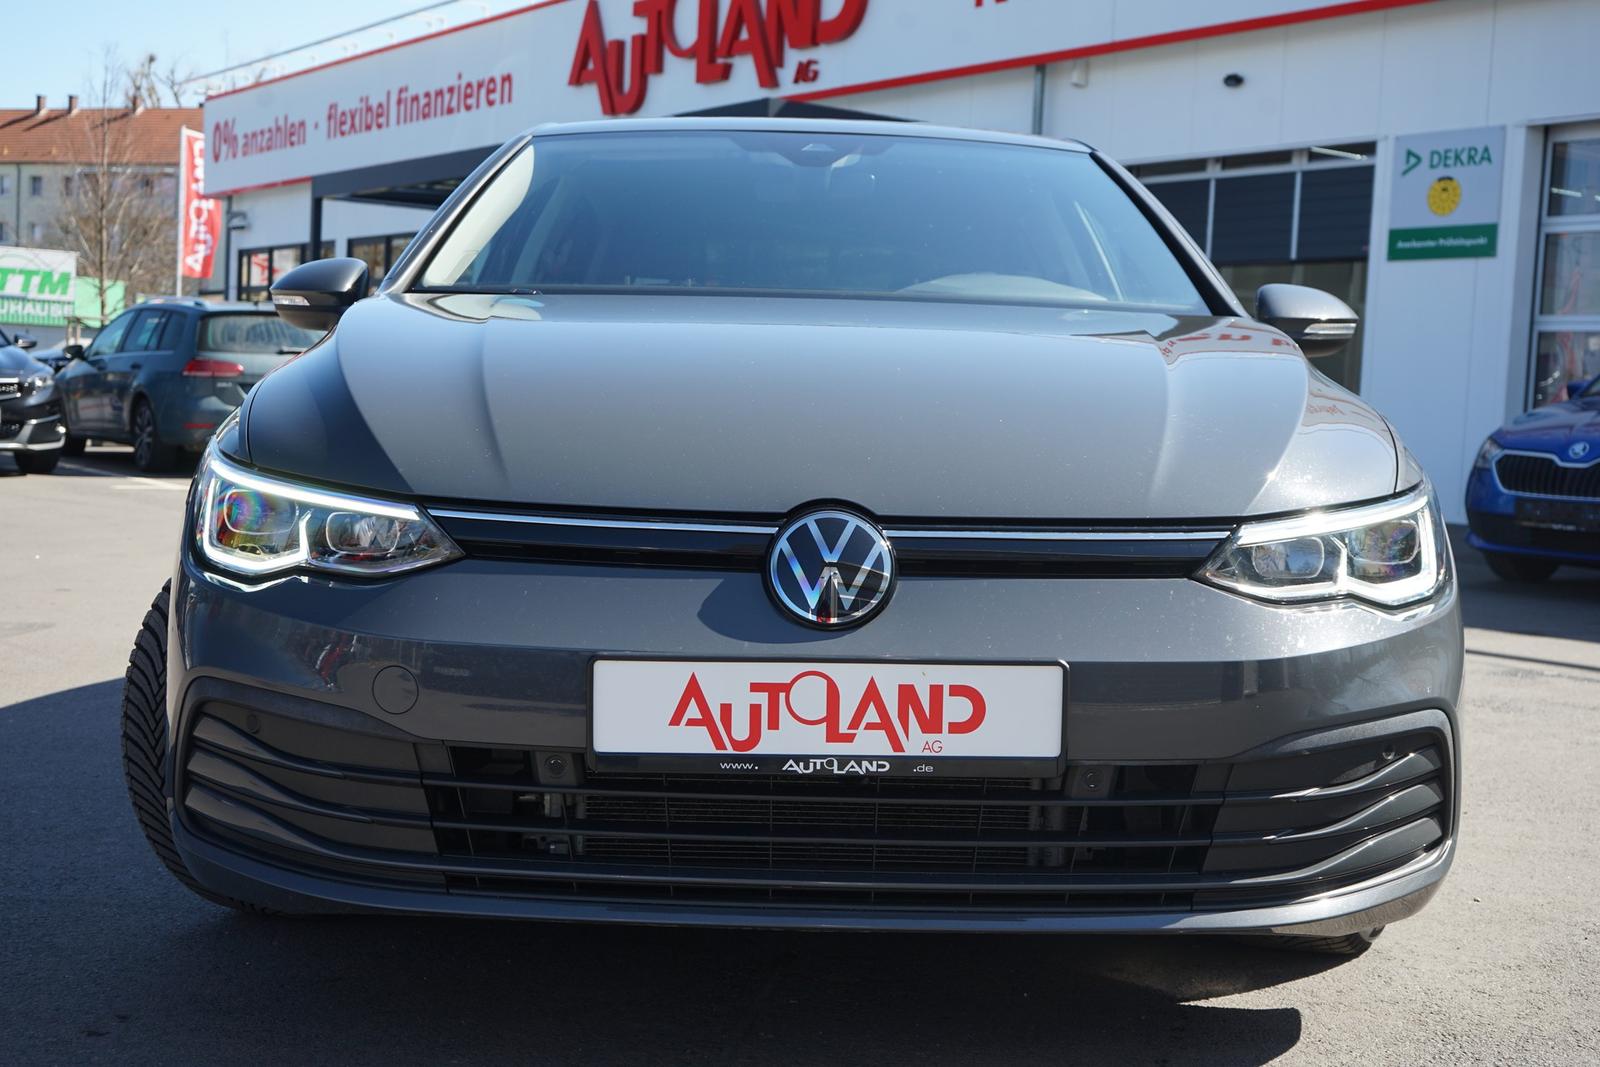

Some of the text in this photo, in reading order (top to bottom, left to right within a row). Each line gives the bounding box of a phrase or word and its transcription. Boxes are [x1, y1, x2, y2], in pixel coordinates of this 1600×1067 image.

[568, 0, 869, 116] AUTOLAND
[794, 60, 820, 84] AG
[212, 72, 514, 163] 0% anzahlen flexibel finanzieren
[1429, 145, 1493, 169] DEKRA
[0, 268, 71, 295] TTM
[668, 670, 987, 753] AUTOLAND
[922, 739, 944, 754] AG
[719, 757, 934, 775] www. AUTOLAND .de
